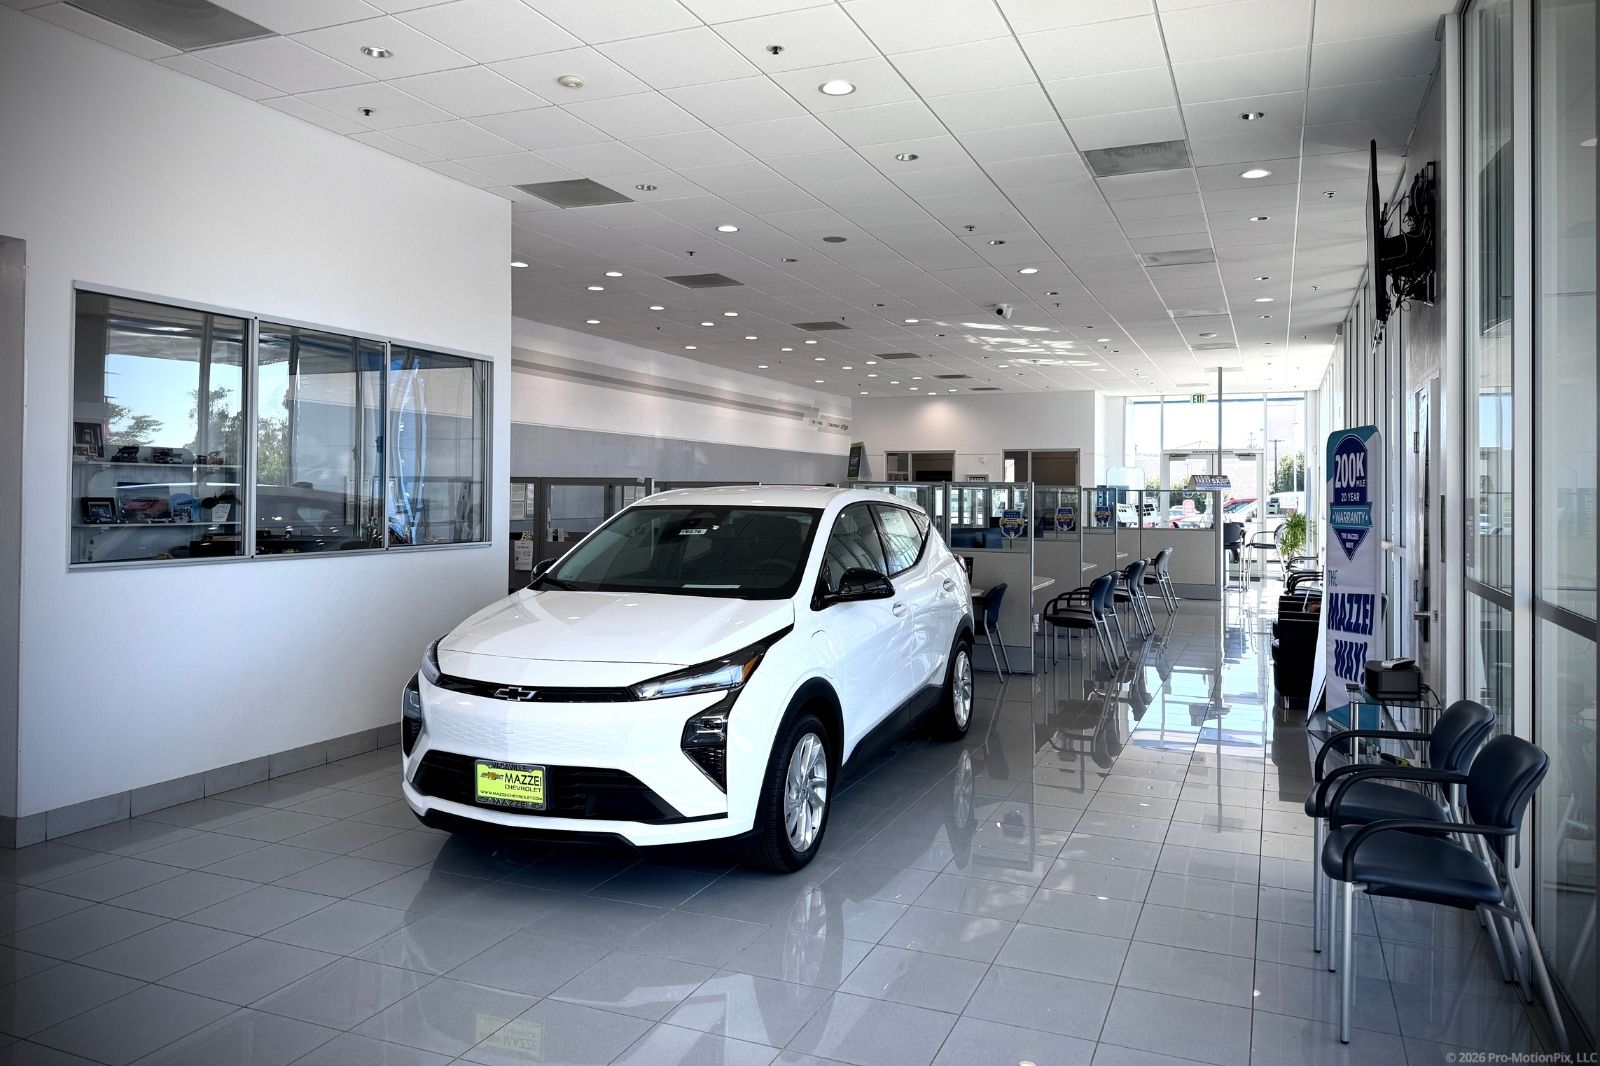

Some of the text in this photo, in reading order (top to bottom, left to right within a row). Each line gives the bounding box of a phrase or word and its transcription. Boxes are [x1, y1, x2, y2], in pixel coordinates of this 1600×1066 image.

[1192, 394, 1205, 403] EXIT
[1335, 452, 1365, 488] 200K
[1356, 479, 1366, 488] MILE
[1341, 492, 1360, 502] 20 YEAR
[1334, 511, 1366, 524] WARRANTY
[1328, 570, 1338, 586] THE
[1327, 593, 1375, 636] MAZZEI
[1334, 639, 1368, 685] WAY!
[504, 773, 542, 786] MAZZEI
[504, 784, 541, 793] CHEVROLET
[492, 798, 528, 808] MAZZEI
